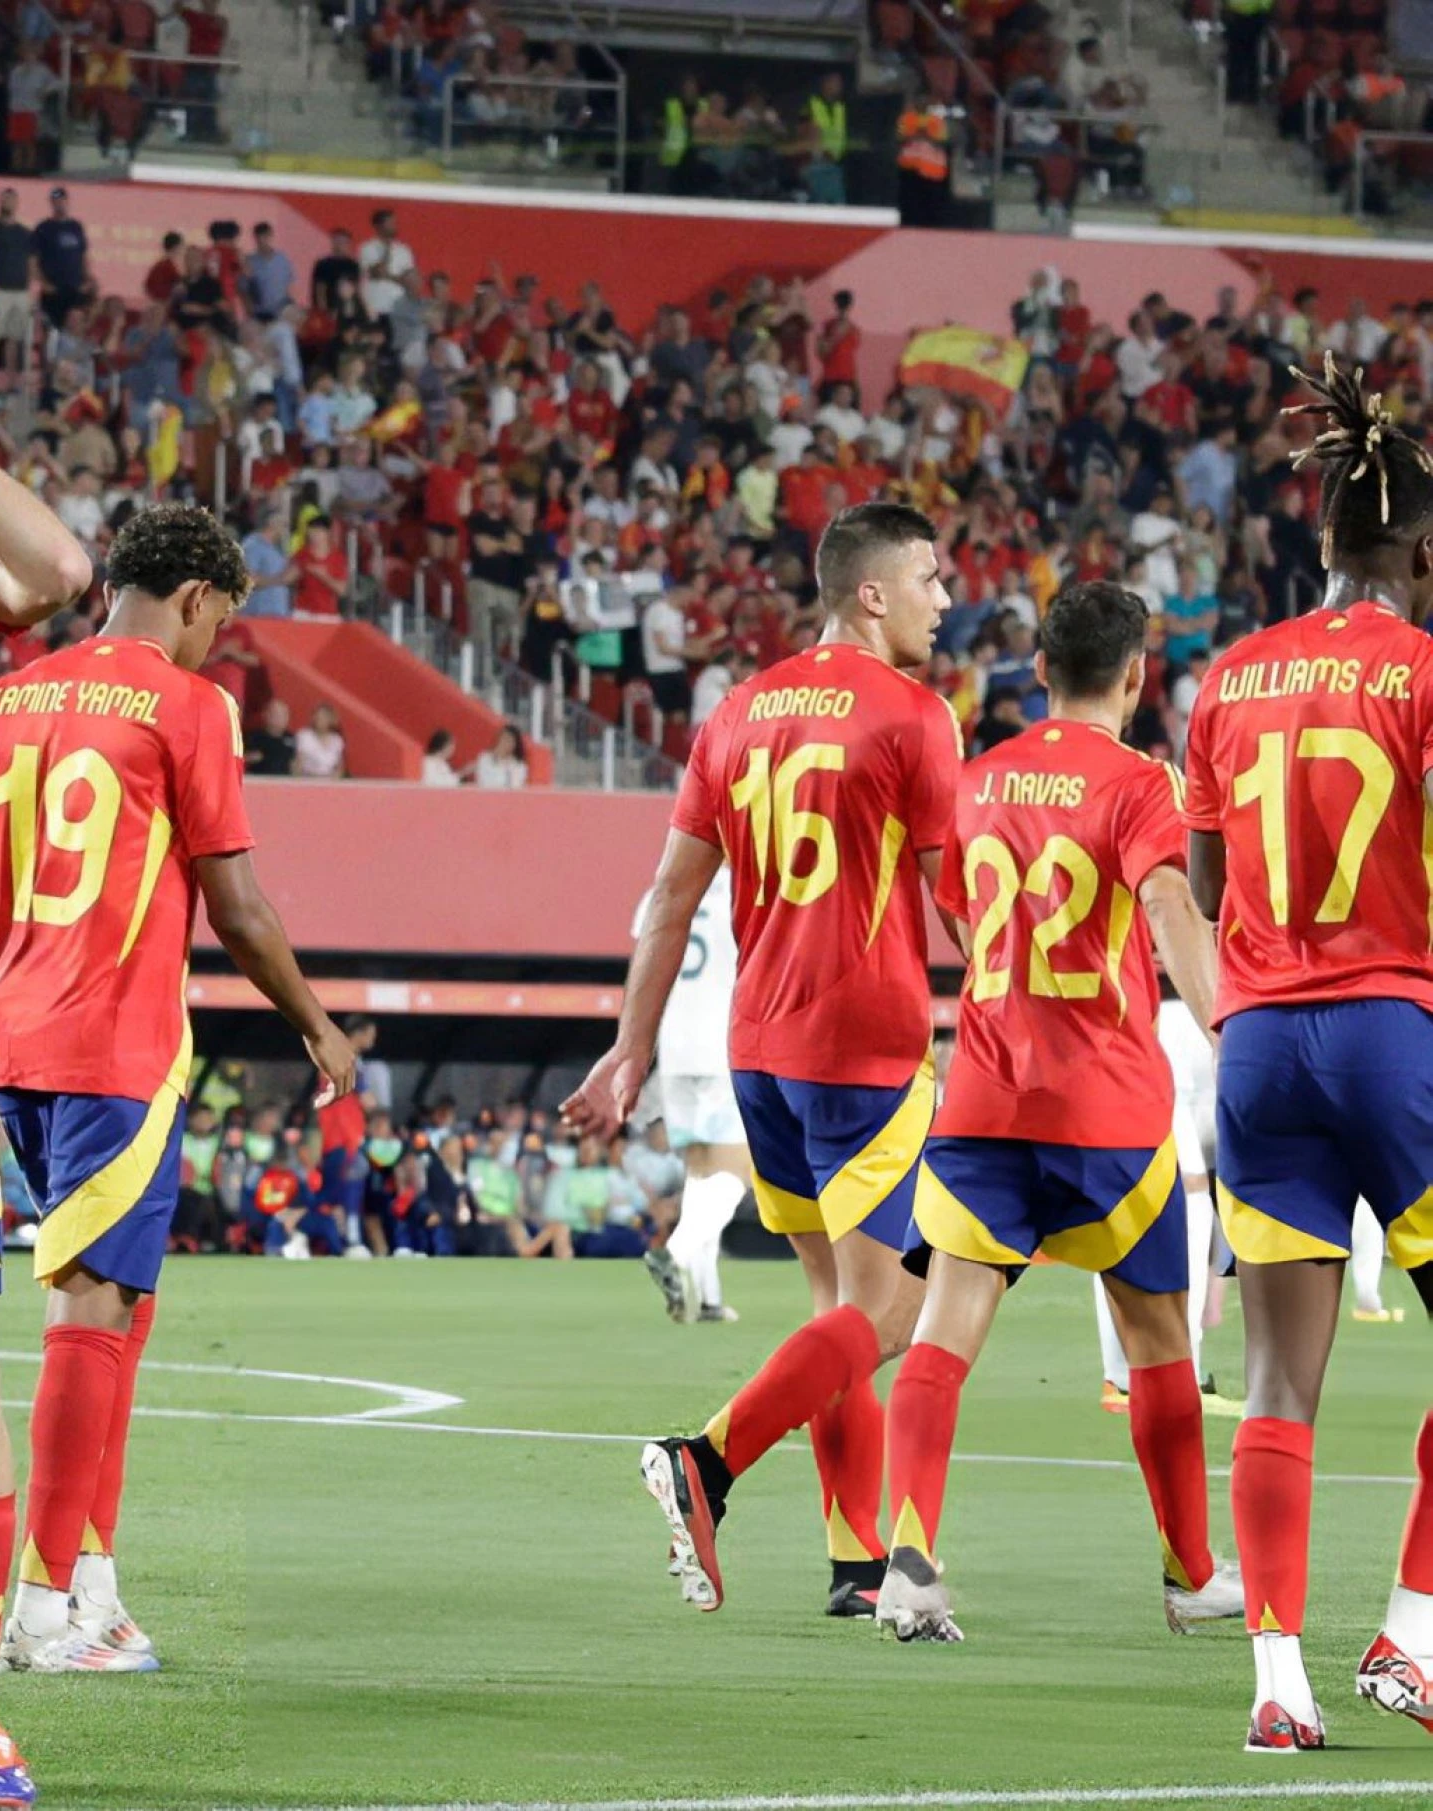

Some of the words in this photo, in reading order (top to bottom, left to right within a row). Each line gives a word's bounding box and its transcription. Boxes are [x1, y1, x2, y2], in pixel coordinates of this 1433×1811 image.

[76, 680, 161, 725] YAMAL
[1219, 657, 1361, 703] WILLIAMS
[1366, 662, 1411, 699] JR.
[747, 686, 855, 722] RODRIGO
[974, 772, 996, 805] J.
[1002, 771, 1086, 807] NAVAS
[730, 743, 845, 906] 16
[1233, 727, 1395, 926] 17
[965, 833, 1101, 1003] 22
